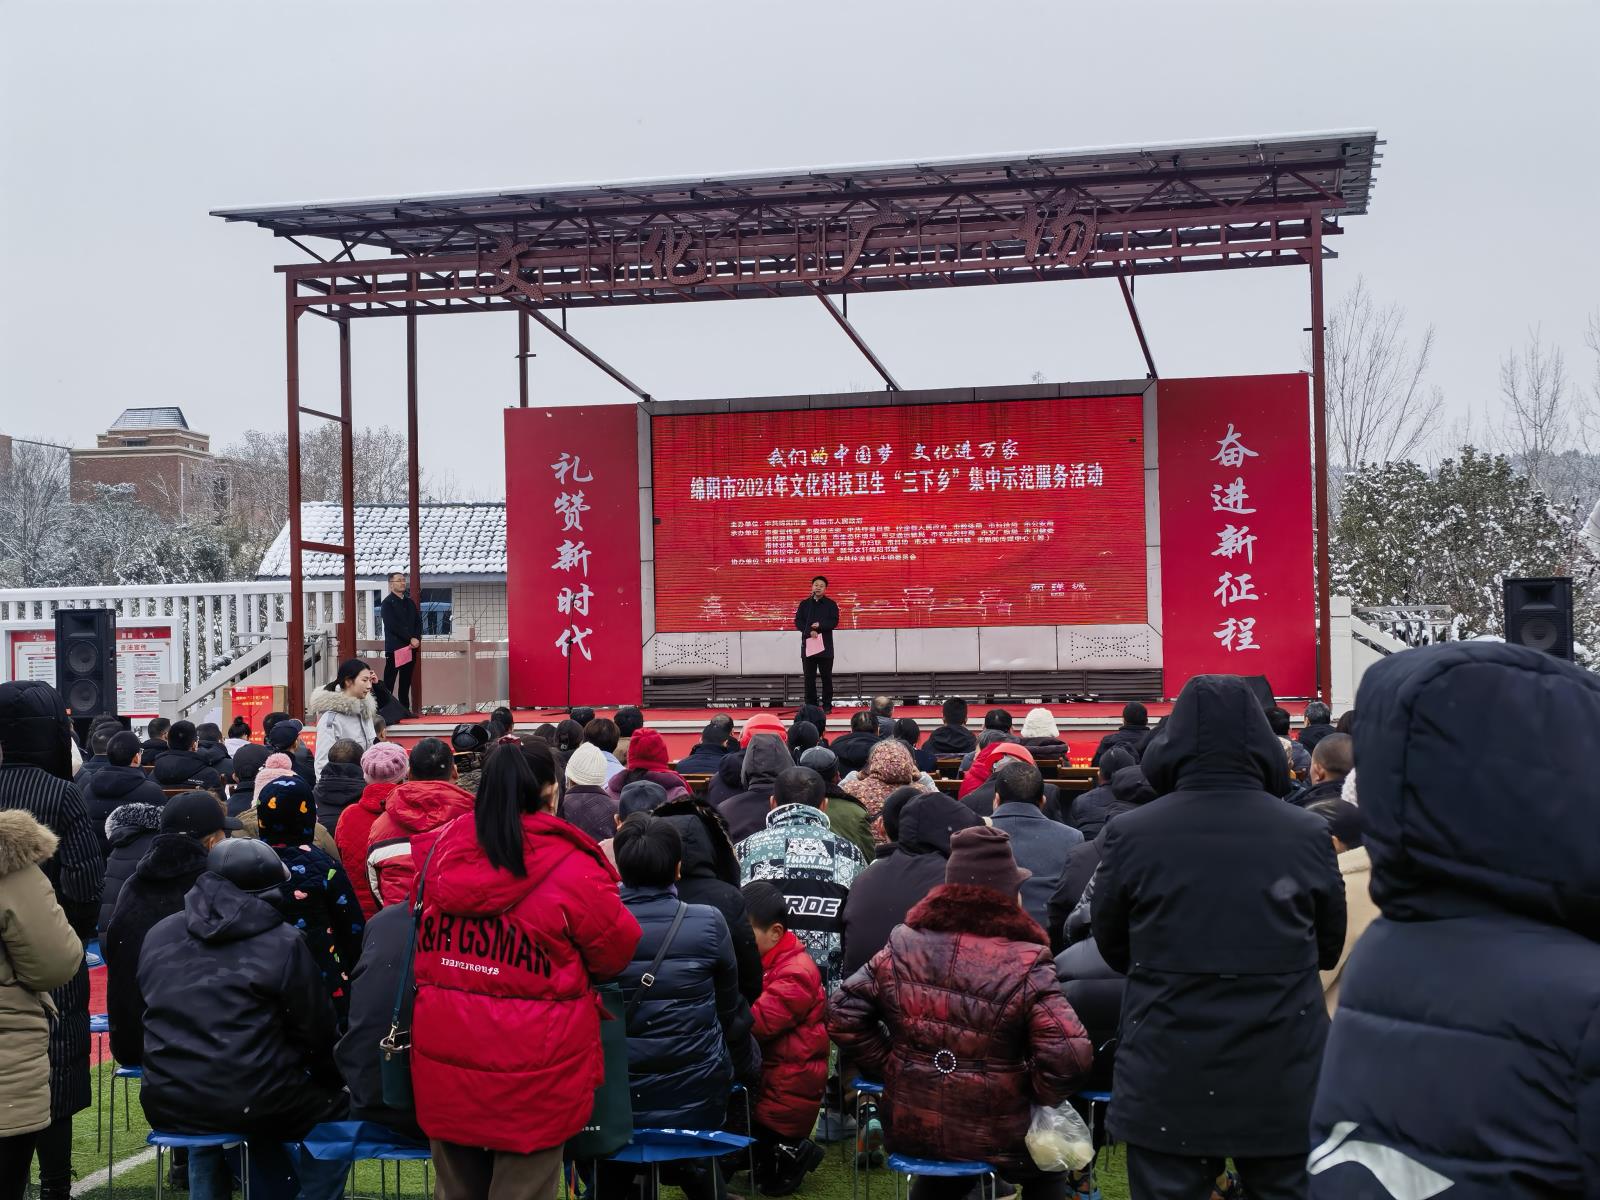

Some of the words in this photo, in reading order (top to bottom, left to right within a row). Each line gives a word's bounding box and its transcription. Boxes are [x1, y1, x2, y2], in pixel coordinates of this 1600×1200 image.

[767, 443, 893, 467] 我们的中国梦
[911, 438, 1019, 461] 文化进万家
[551, 452, 594, 661] 礼赞新时代
[1210, 423, 1261, 652] 奋进新征程
[785, 855, 816, 864] TURN
